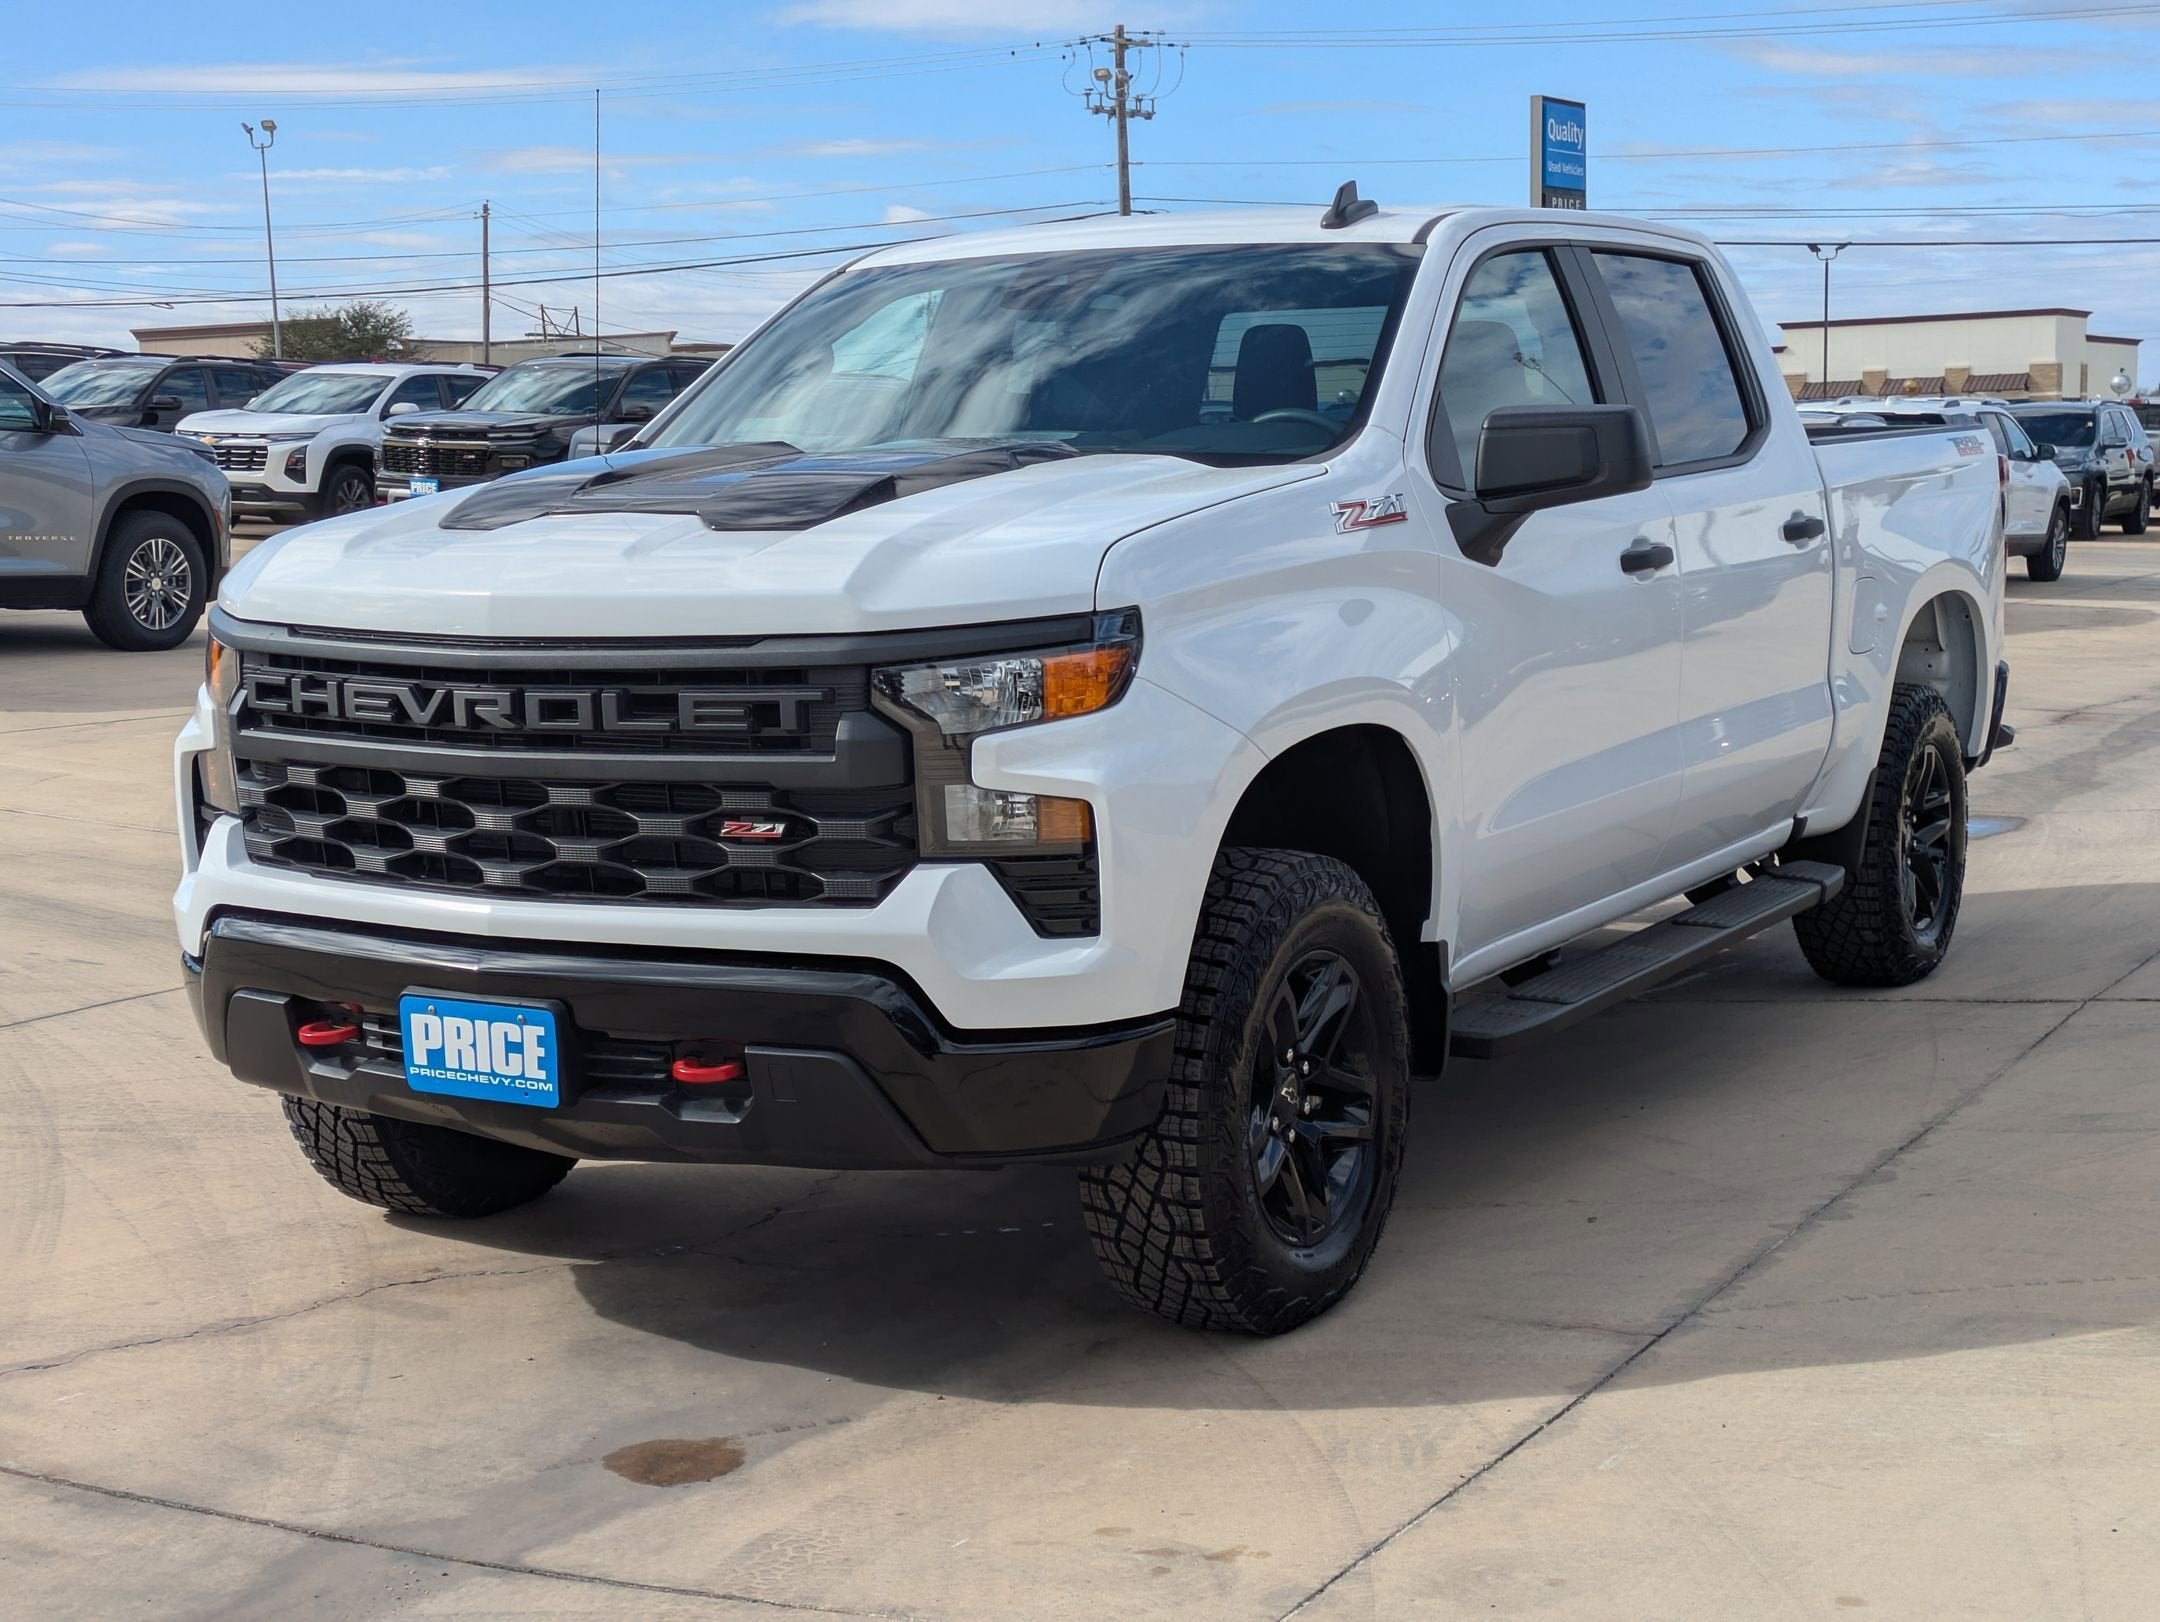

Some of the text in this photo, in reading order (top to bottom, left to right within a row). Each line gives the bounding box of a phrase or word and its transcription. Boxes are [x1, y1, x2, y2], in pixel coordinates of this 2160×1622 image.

[1548, 118, 1584, 150] Quality
[1548, 160, 1584, 176] Used Vehicles
[1552, 197, 1582, 209] PRICE
[411, 481, 438, 495] PRICE
[1329, 494, 1408, 534] Z71
[247, 673, 834, 732] CHEVROLET
[720, 821, 785, 837] Z71
[410, 1013, 547, 1080] PRICE
[409, 1066, 553, 1092] PRICECHEVY.COM
